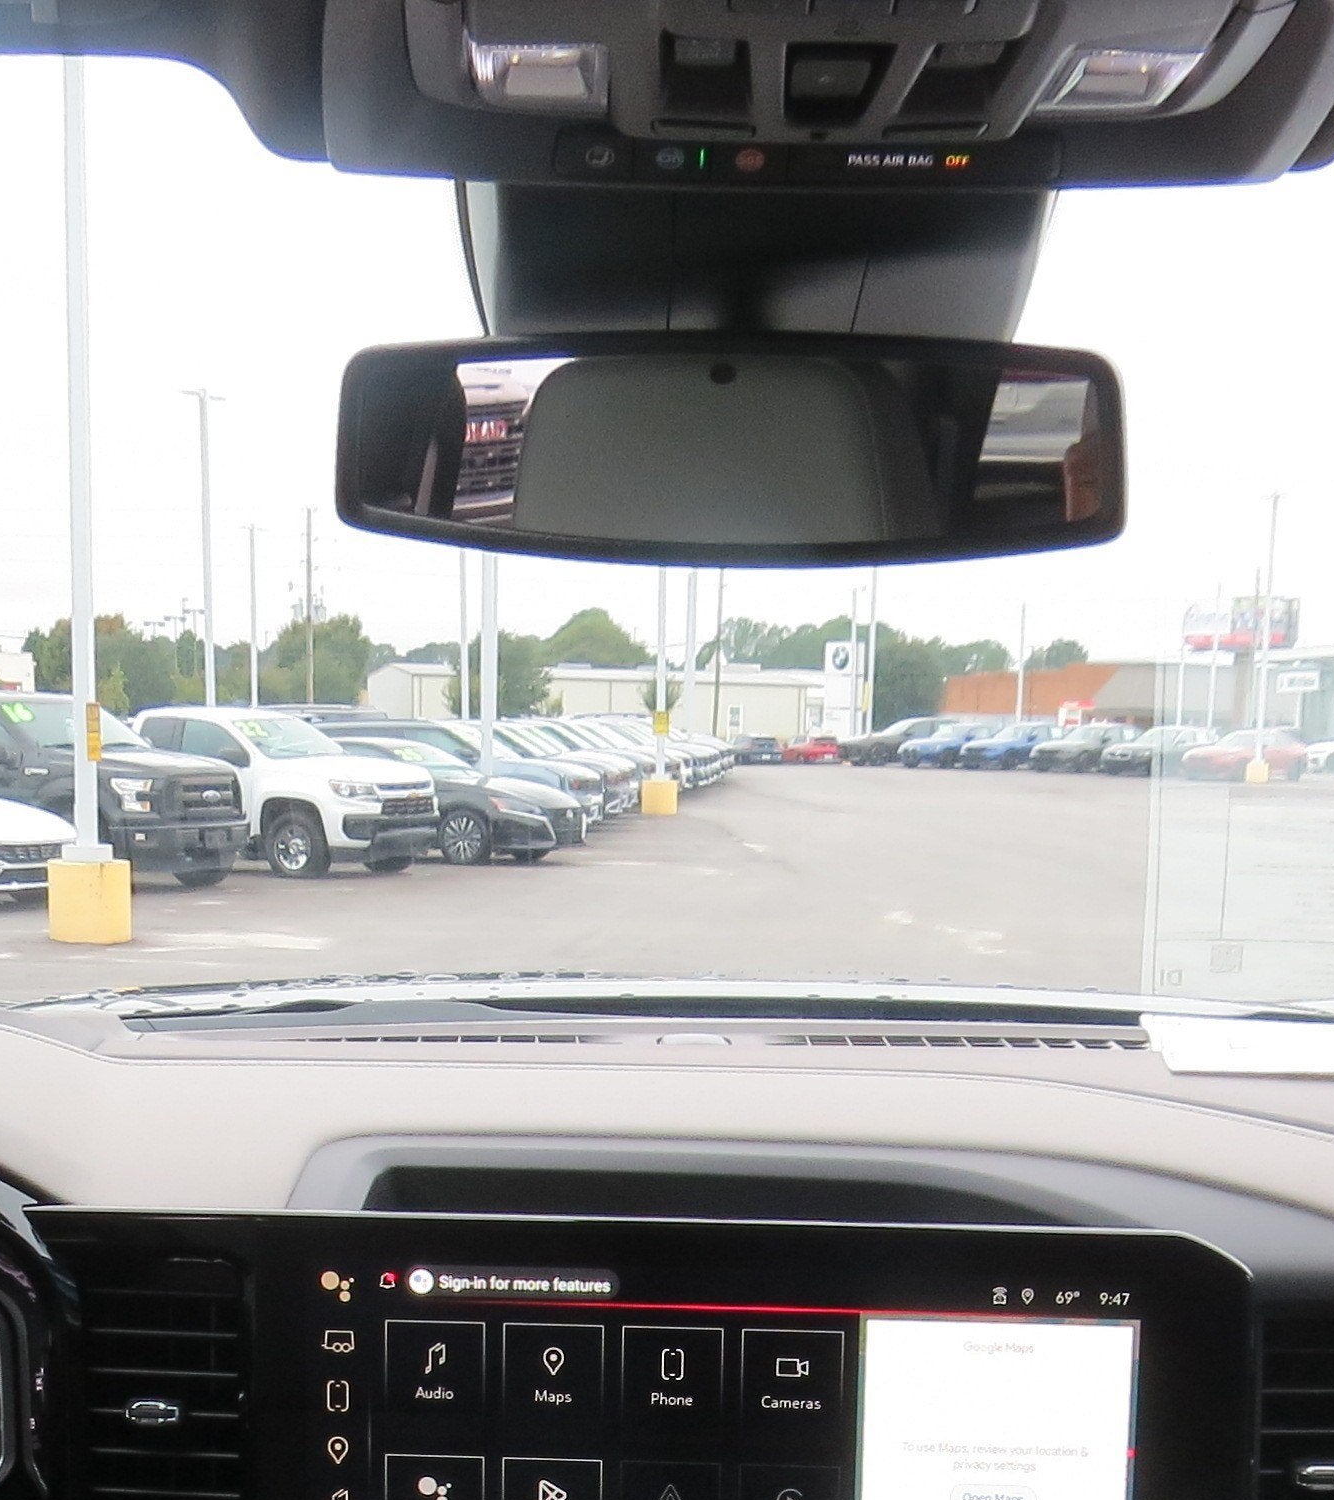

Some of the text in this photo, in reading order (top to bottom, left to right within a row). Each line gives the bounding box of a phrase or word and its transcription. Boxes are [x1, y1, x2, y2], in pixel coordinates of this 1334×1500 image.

[847, 155, 970, 167] PASS AIR BAG OFF
[438, 1275, 612, 1293] Sign-in for more features
[1099, 1292, 1131, 1306] 9:47
[415, 1387, 454, 1400] Audio
[534, 1390, 572, 1405] Maps
[651, 1392, 693, 1406] Phone
[761, 1396, 822, 1410] Cameras
